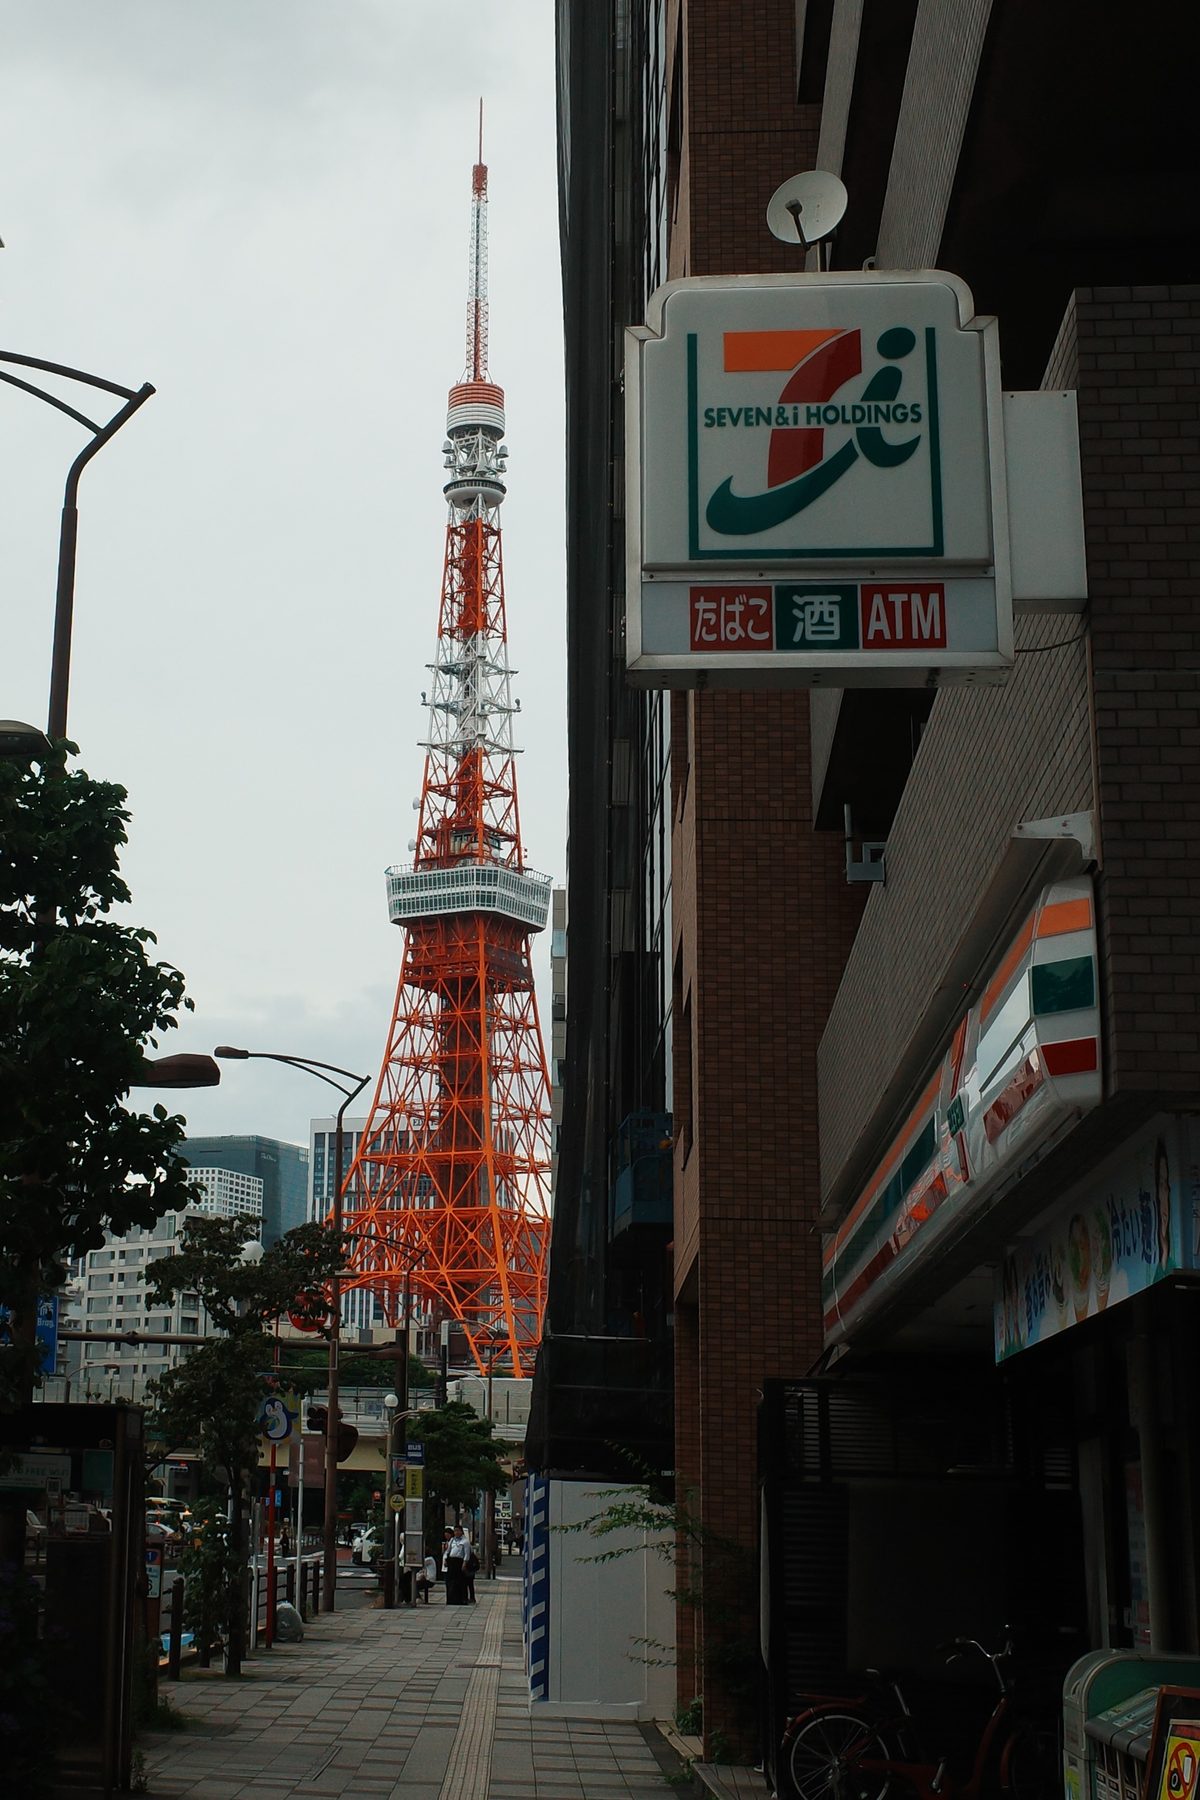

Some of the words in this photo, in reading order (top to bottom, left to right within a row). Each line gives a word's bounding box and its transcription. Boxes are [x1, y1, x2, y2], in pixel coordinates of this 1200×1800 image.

[804, 402, 923, 427] HOLDINGS
[694, 593, 771, 643] たばこ
[791, 593, 841, 643] 酒
[866, 592, 942, 641] ATM
